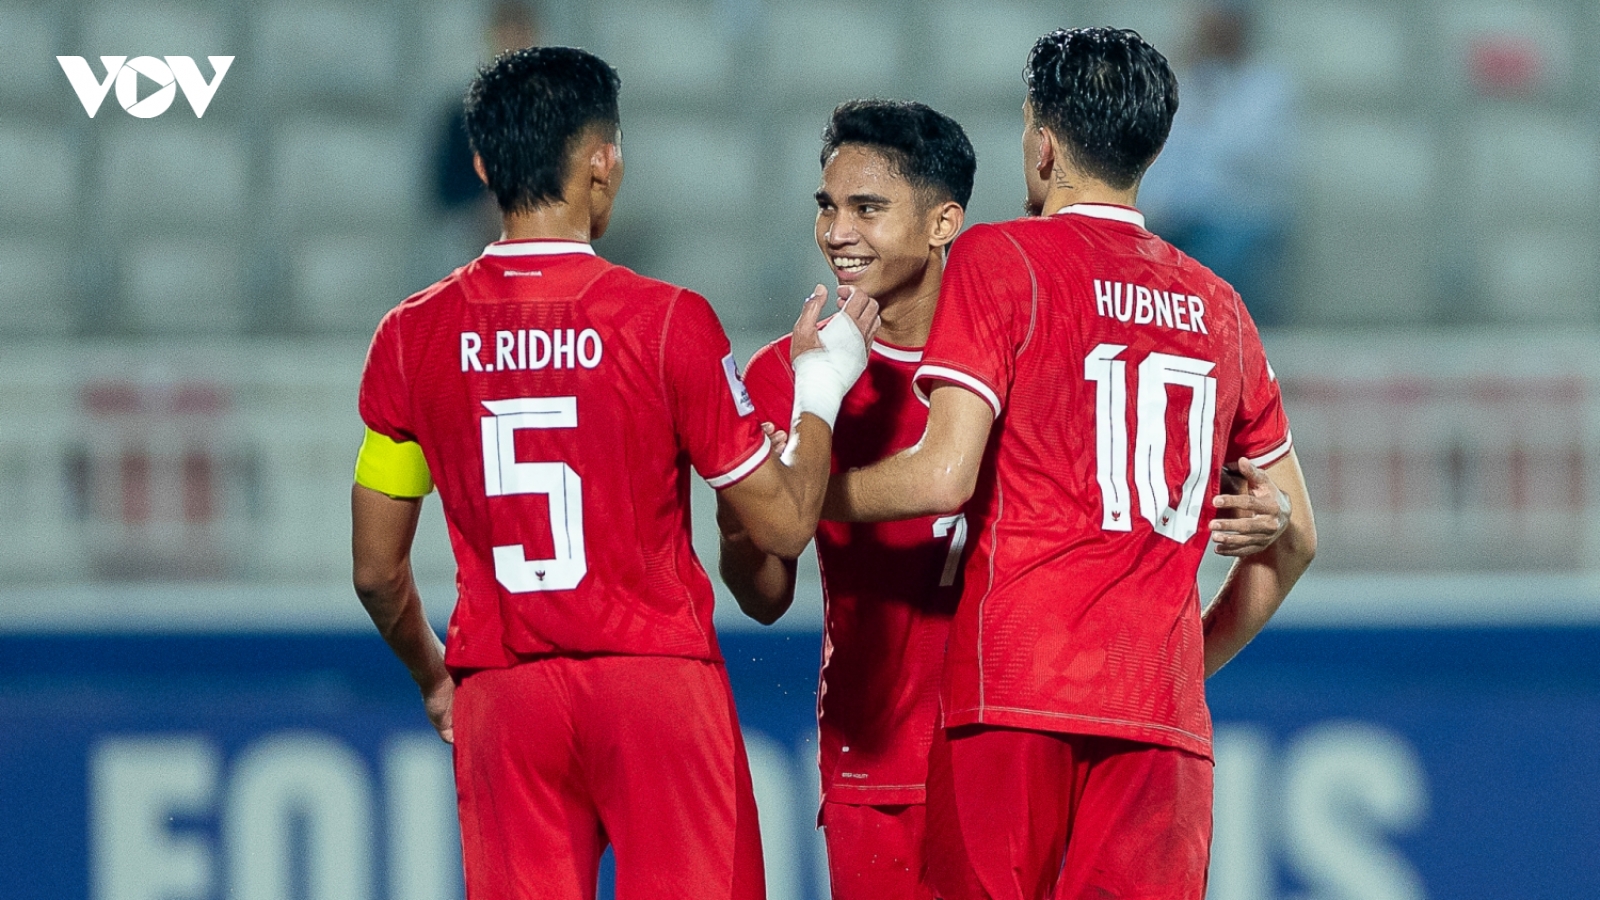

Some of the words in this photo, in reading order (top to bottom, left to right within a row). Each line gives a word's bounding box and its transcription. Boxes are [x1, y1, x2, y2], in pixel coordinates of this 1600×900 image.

[1093, 279, 1209, 334] HUBNER
[460, 328, 603, 372] R.RIDHO
[1084, 343, 1217, 544] 10
[480, 396, 588, 594] 5
[932, 512, 968, 587] 7
